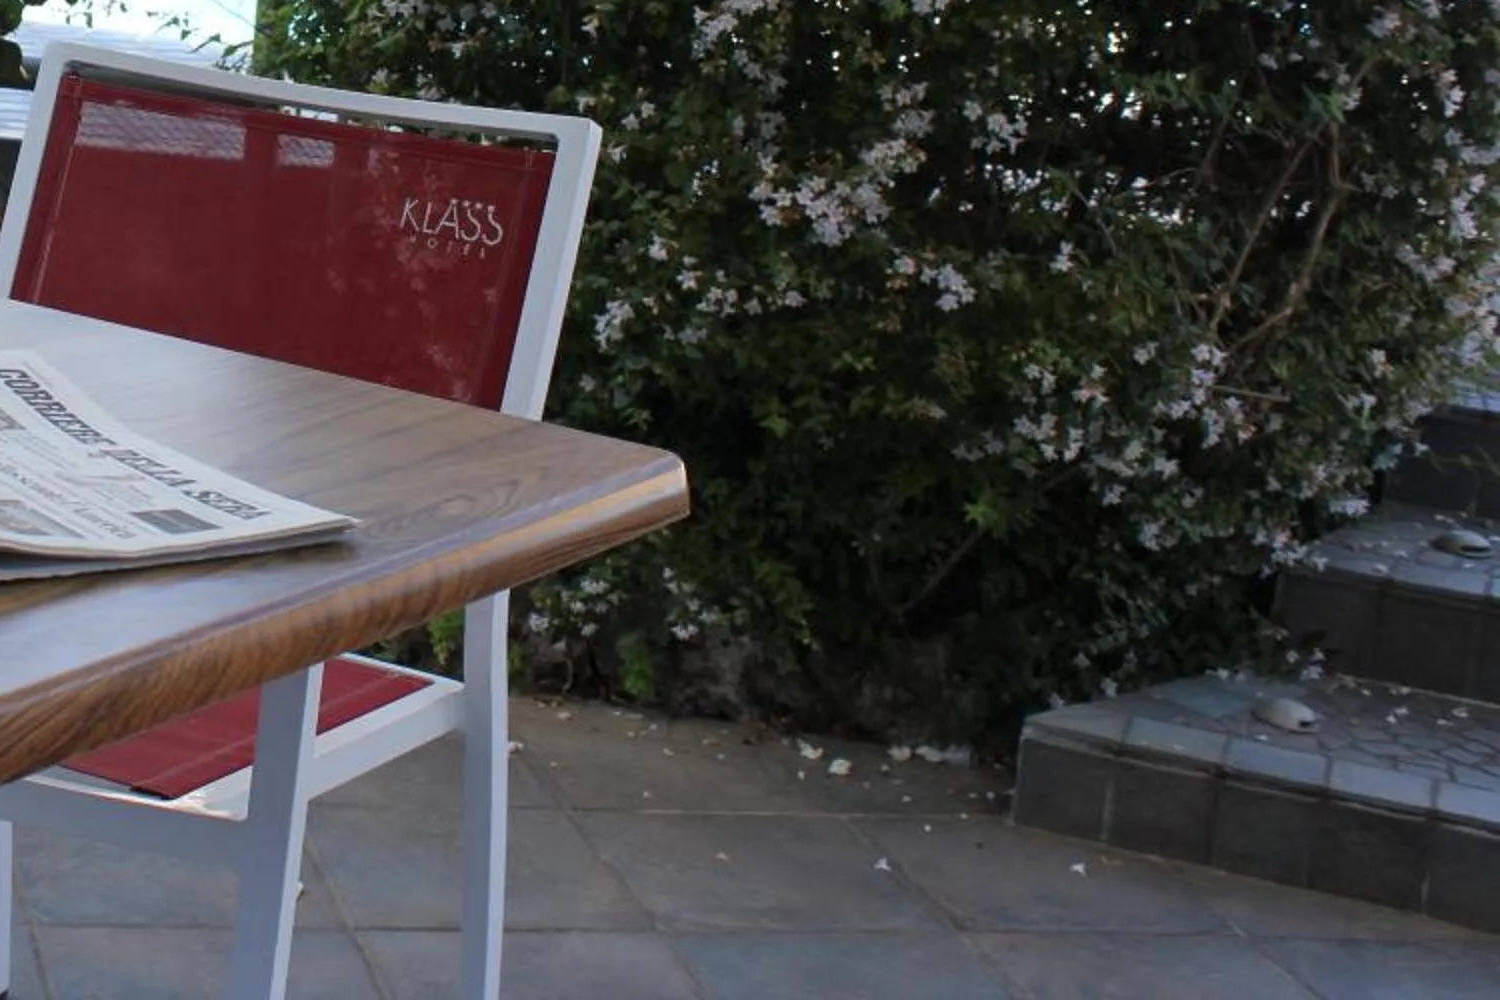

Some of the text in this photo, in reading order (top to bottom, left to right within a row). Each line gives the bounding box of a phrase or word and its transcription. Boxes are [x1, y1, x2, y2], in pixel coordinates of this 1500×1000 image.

[400, 198, 503, 246] KLASS
[100, 448, 197, 487] DELLA
[180, 489, 272, 521] SERA
